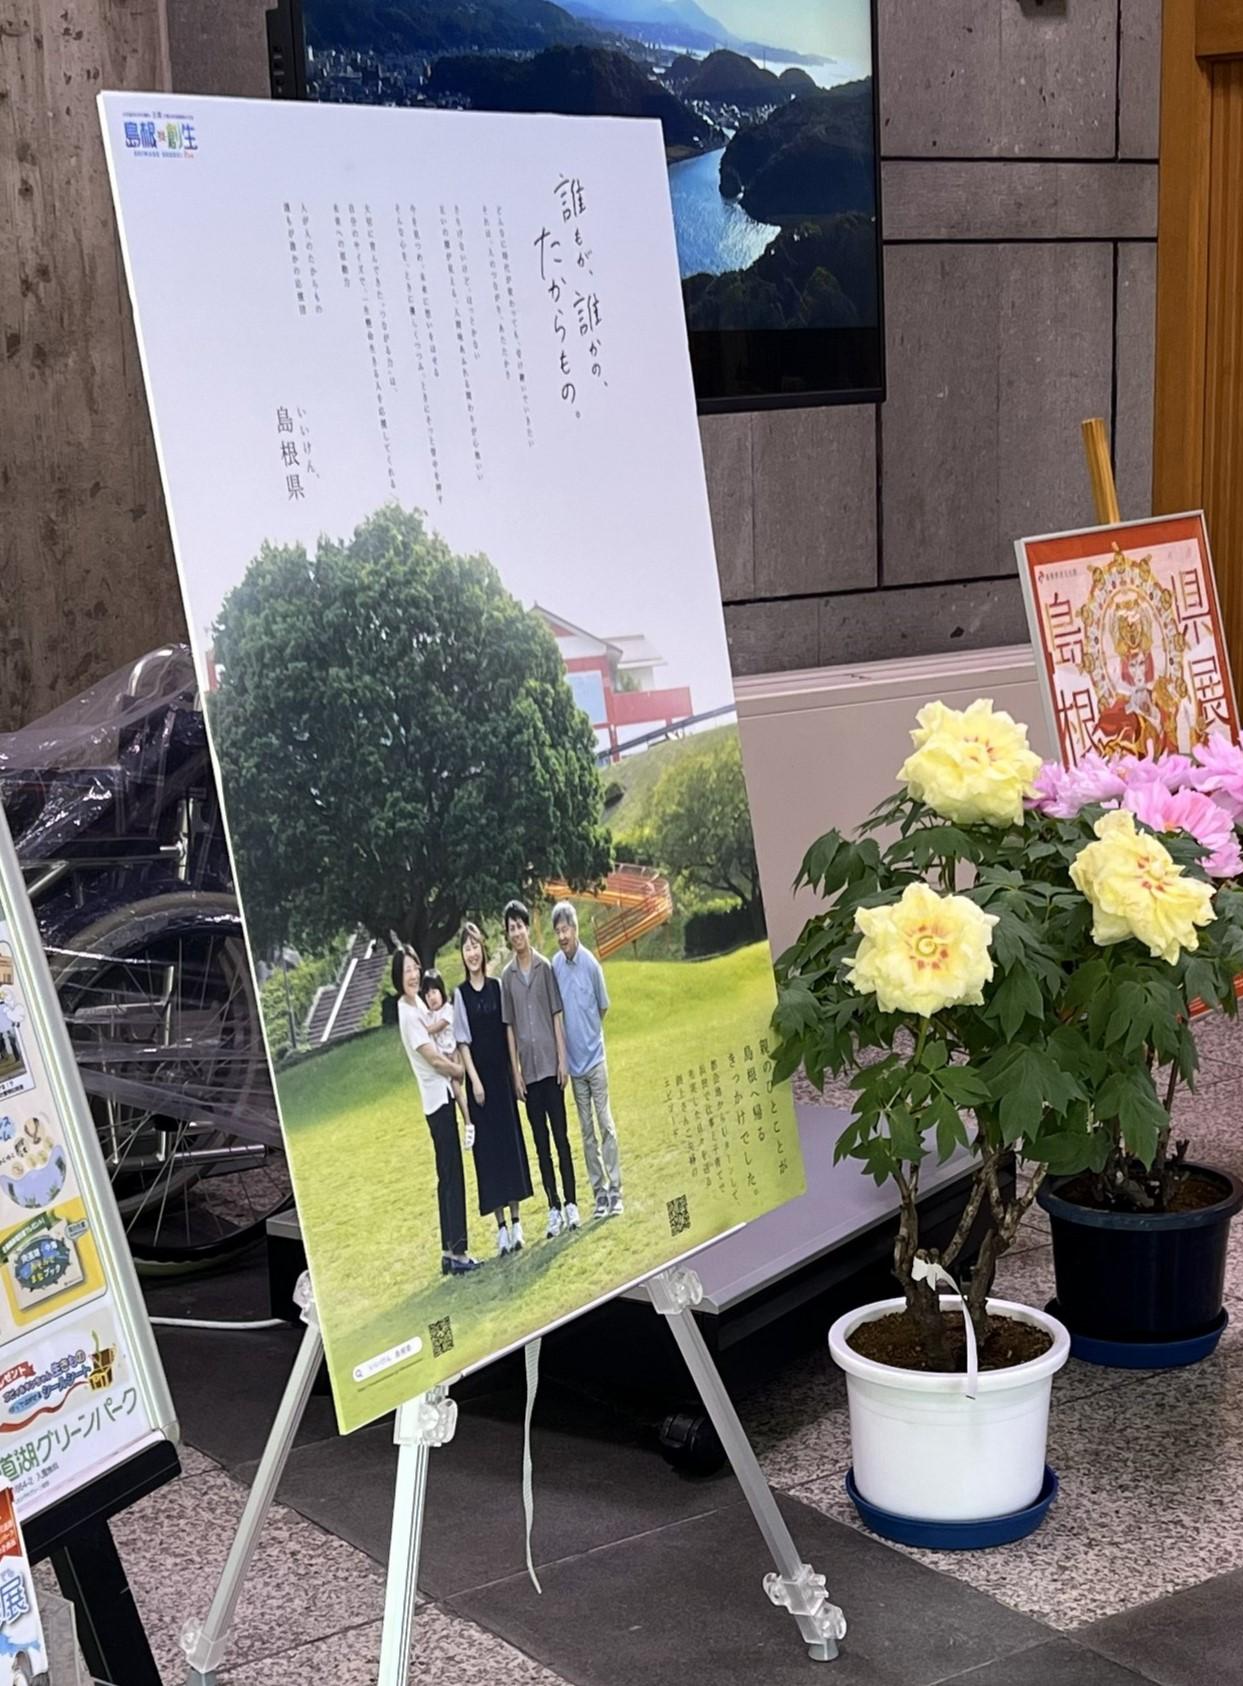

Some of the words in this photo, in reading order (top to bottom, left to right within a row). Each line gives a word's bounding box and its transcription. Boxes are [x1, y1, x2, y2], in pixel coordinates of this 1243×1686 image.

[533, 226, 581, 419] たからもの。
[553, 173, 608, 387] 誰もが、誰かの、
[276, 405, 305, 501] 島根県
[296, 406, 320, 478] いいけん、
[1046, 592, 1099, 769] 島根
[1170, 567, 1232, 729] 県展
[728, 1052, 760, 1197] きっかけでした。
[743, 1044, 766, 1142] 島根へ帰る
[758, 1038, 789, 1176] 親のひとことが
